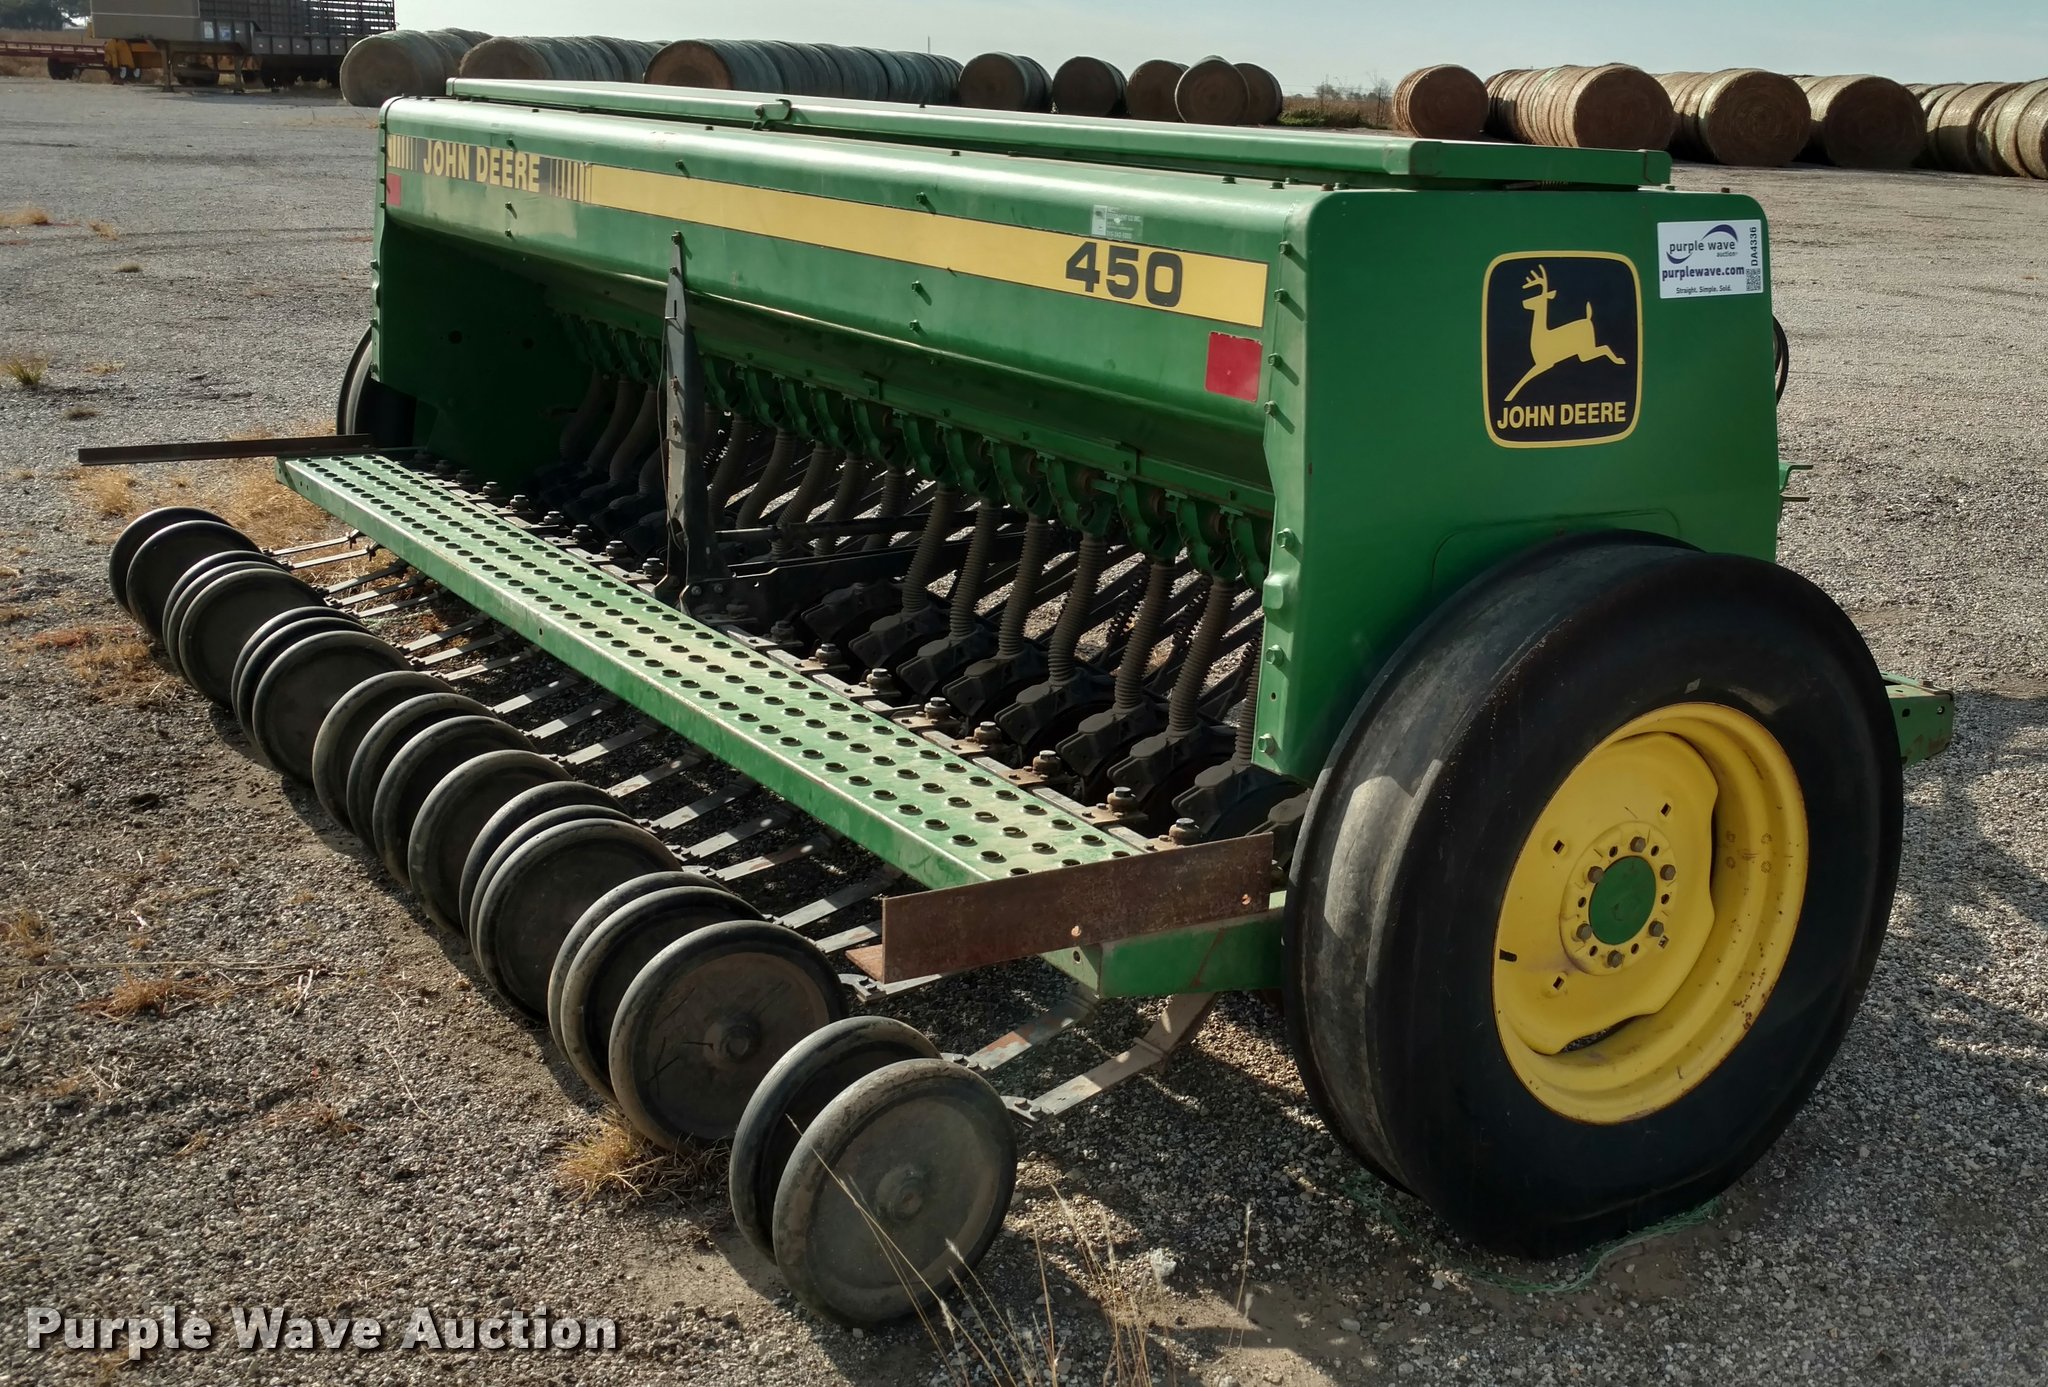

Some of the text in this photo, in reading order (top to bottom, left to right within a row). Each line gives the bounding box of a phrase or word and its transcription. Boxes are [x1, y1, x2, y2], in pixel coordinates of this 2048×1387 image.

[423, 139, 540, 193] JOHN DEERE
[1669, 240, 1736, 254] purple wave
[1749, 226, 1758, 267] DA4336
[1065, 241, 1183, 308] 450
[1662, 265, 1745, 281] purplewave.com
[1676, 284, 1732, 295] Straight. Simple. Sold.
[1497, 401, 1626, 429] JOHN DEERE
